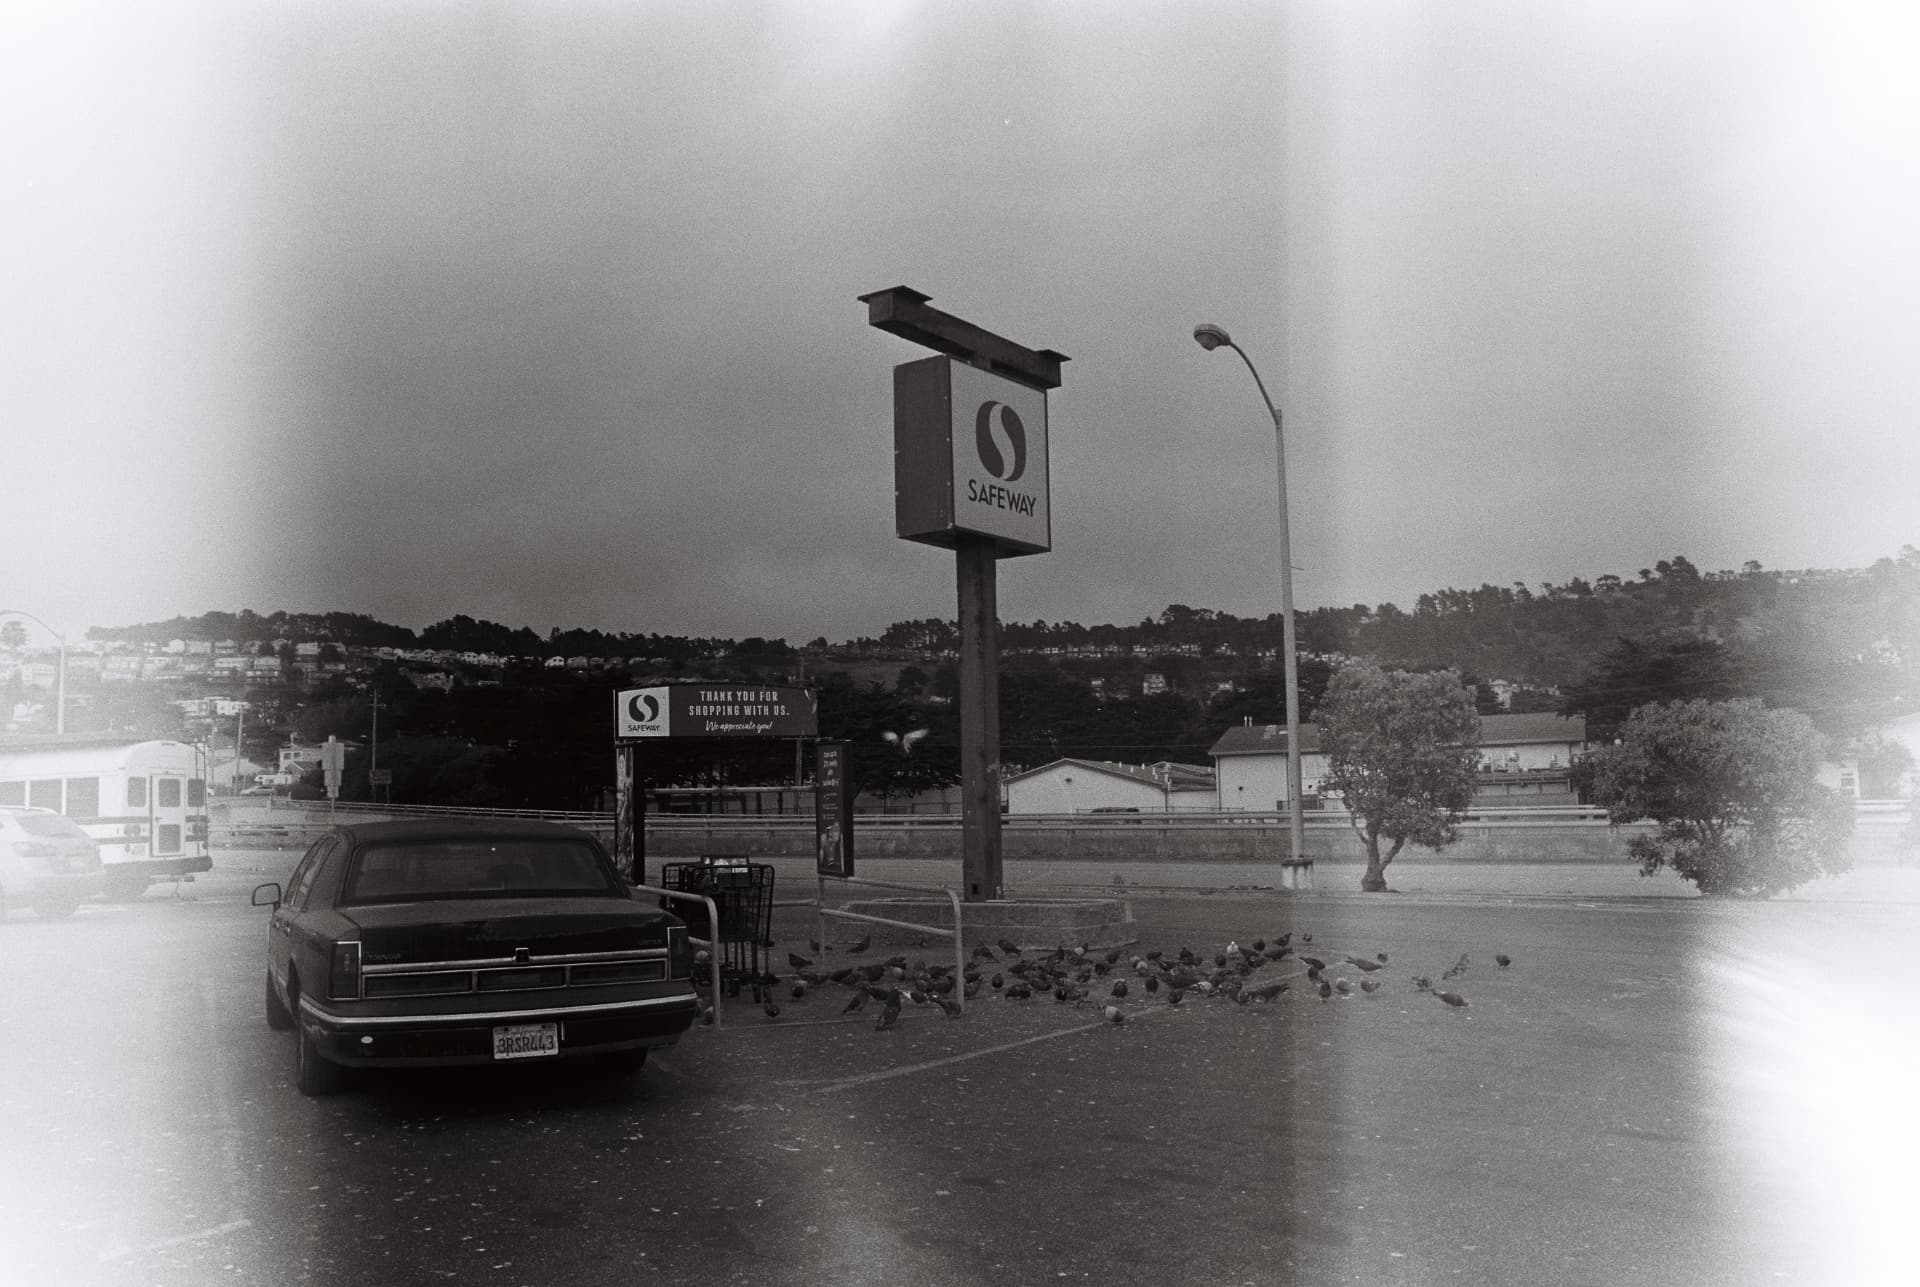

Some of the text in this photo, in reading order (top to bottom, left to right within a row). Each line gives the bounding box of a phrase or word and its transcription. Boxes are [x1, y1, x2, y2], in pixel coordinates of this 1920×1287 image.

[968, 479, 1036, 517] SAFEWAY
[700, 690, 778, 702] THANK YOU FOR
[689, 705, 790, 716] SHOPPING WITH US.
[628, 724, 660, 732] SAFEWAY
[706, 720, 772, 733] We appreciate you!
